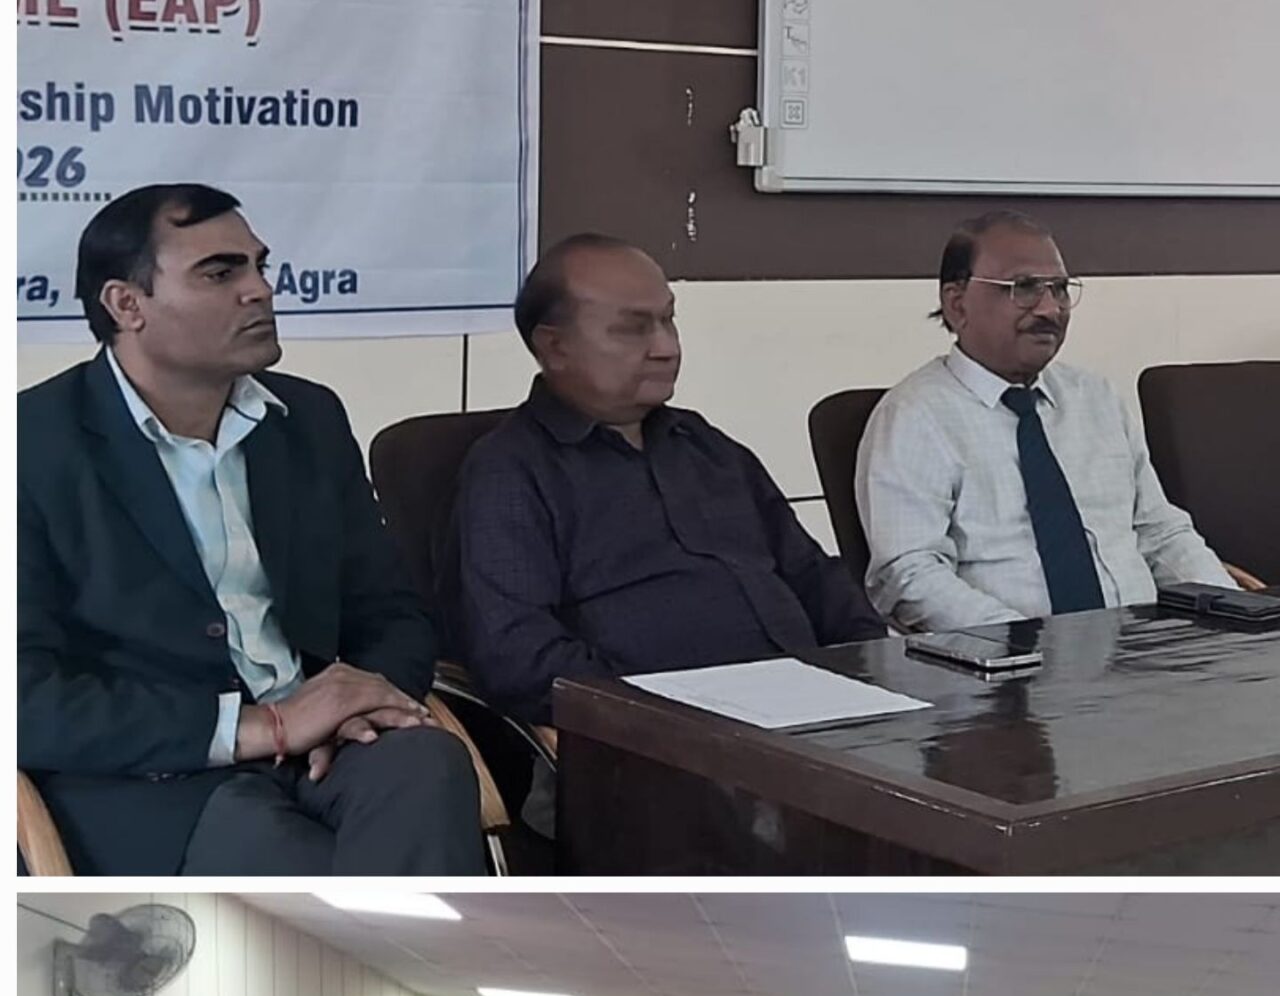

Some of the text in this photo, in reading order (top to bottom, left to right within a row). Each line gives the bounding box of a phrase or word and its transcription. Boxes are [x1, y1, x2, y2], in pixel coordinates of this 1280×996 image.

[20, 81, 359, 131] ship Motivation
[17, 145, 86, 188] 26
[274, 262, 358, 304] Agra
